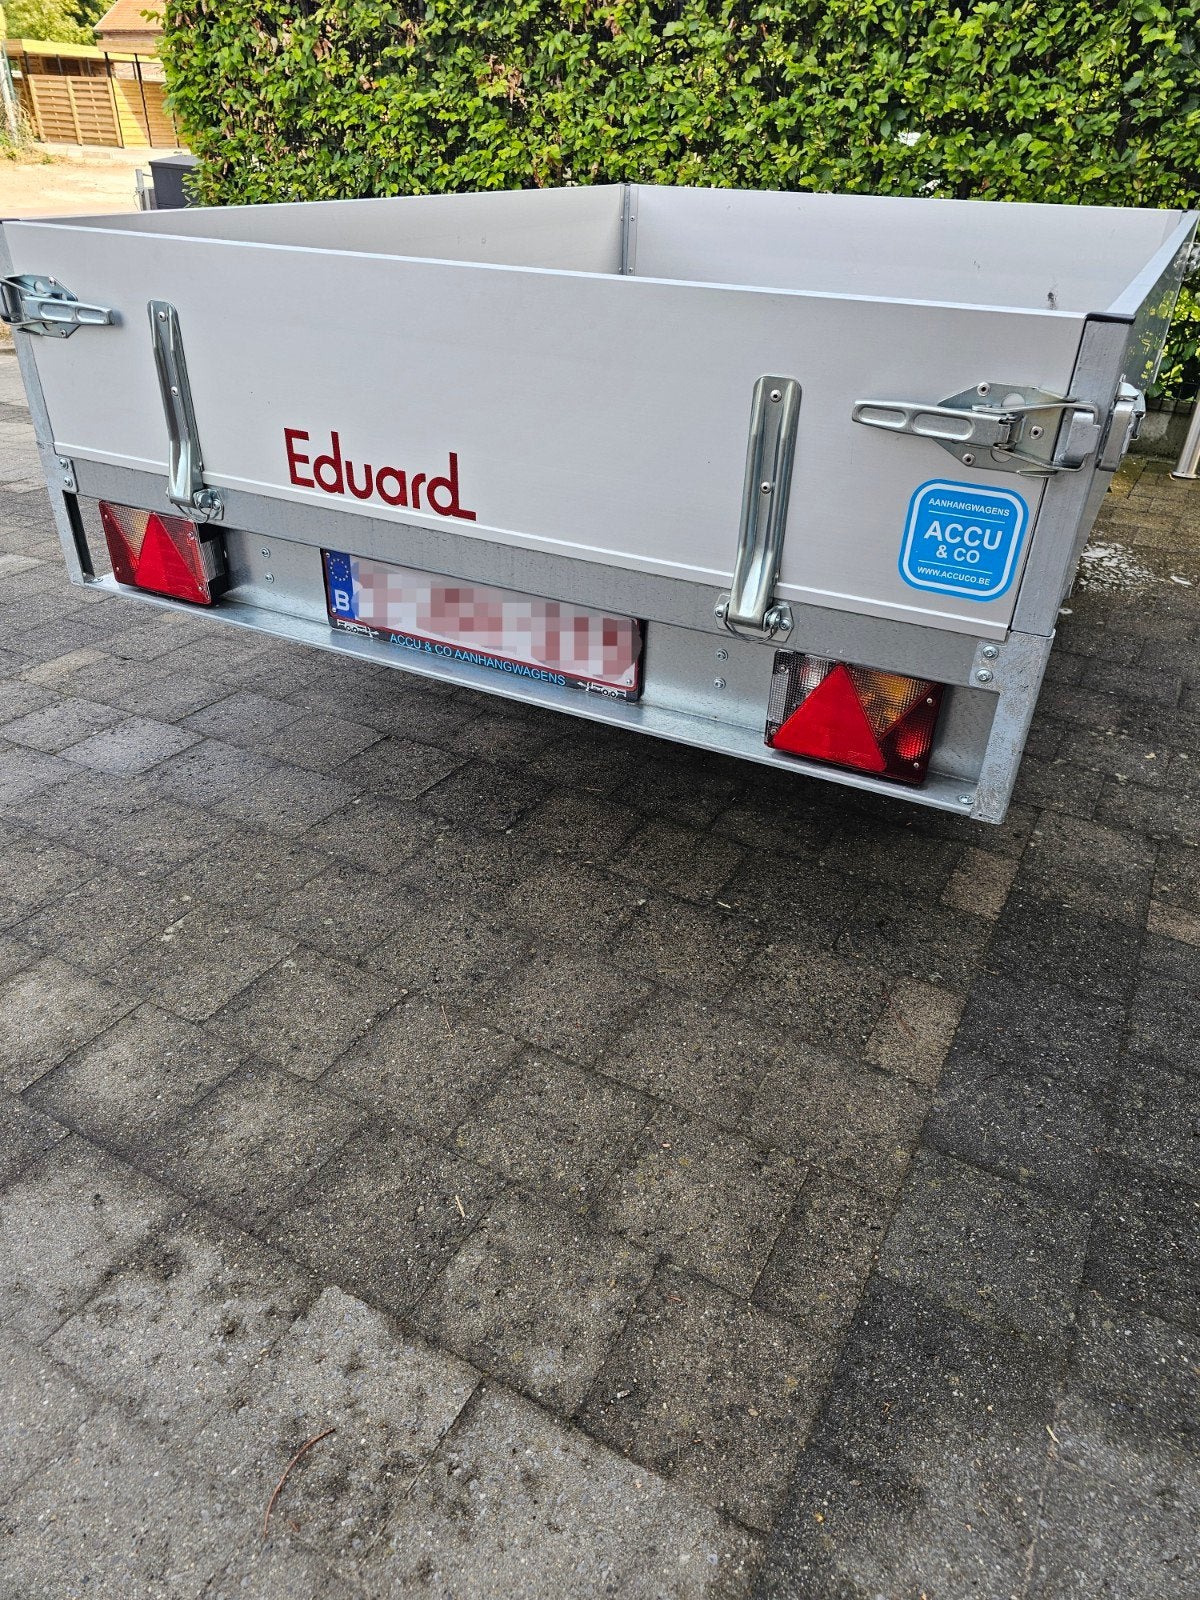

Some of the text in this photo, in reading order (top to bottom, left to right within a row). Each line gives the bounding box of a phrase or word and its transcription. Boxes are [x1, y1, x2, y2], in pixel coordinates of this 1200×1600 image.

[284, 427, 476, 521] Eduard
[928, 498, 1010, 517] AANHANGWAGENS
[924, 520, 1003, 550] ACCU
[936, 544, 980, 564] & CO
[917, 566, 991, 586] WWW.ACCUCO.BE
[334, 589, 350, 611] B
[390, 633, 566, 686] ACCU & CO AANHANGWAGENS
